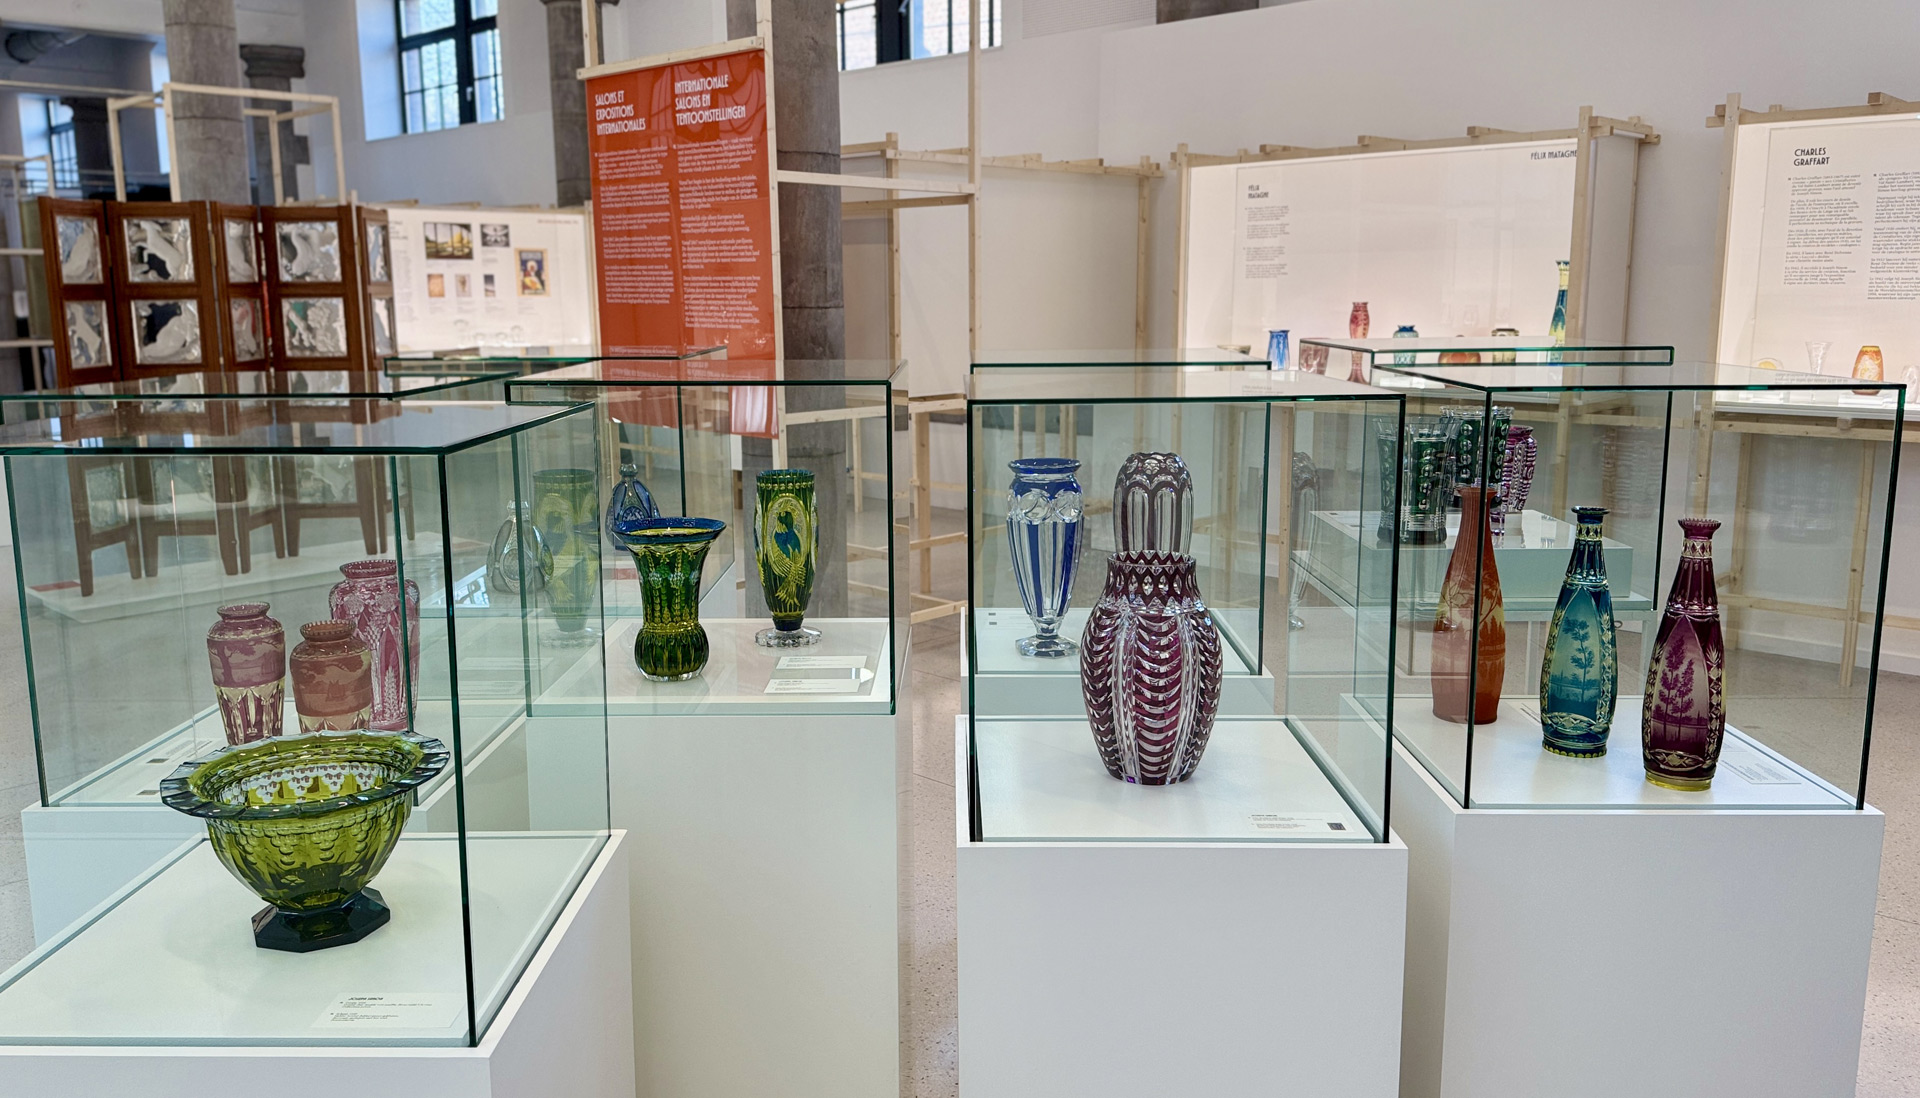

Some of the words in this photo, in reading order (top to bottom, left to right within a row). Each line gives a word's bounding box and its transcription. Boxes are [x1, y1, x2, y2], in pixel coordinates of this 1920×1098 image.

[674, 74, 728, 94] INTERNATIONALE
[595, 92, 617, 106] SALONS
[618, 90, 624, 102] ET
[675, 96, 700, 110] SALONS
[702, 94, 711, 107] EN
[596, 104, 634, 121] EXPOSITIONS
[676, 105, 746, 126] TENTOONSTELLINGEN
[596, 118, 646, 136] INTERNATIONALES
[1530, 151, 1546, 160] FÉLIX
[1794, 147, 1826, 156] CHARLES
[1794, 156, 1830, 166] GRAFFART
